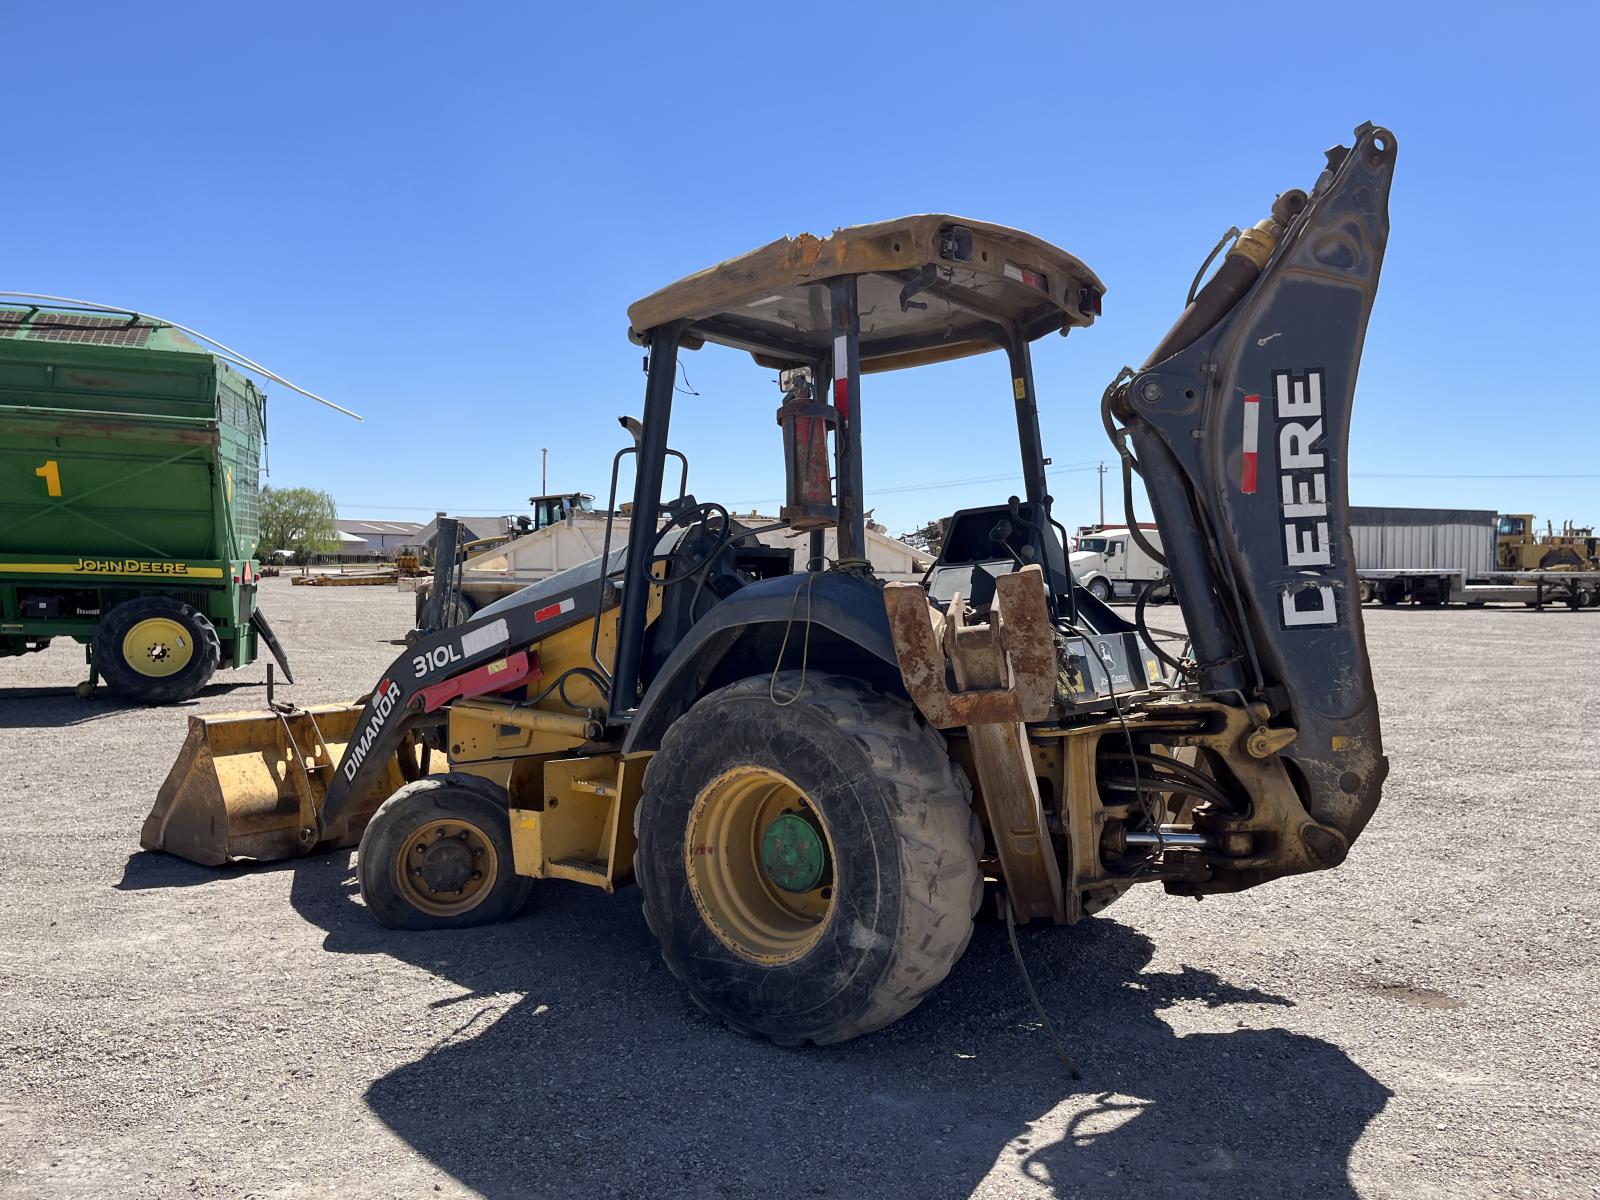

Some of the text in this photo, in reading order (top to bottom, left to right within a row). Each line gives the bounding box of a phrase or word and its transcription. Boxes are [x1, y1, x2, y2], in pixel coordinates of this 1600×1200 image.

[35, 460, 62, 497] 1
[1276, 373, 1338, 626] DEERE
[74, 558, 187, 574] JOHN DEERE
[412, 644, 462, 678] 310L
[343, 681, 401, 783] DIMANOR
